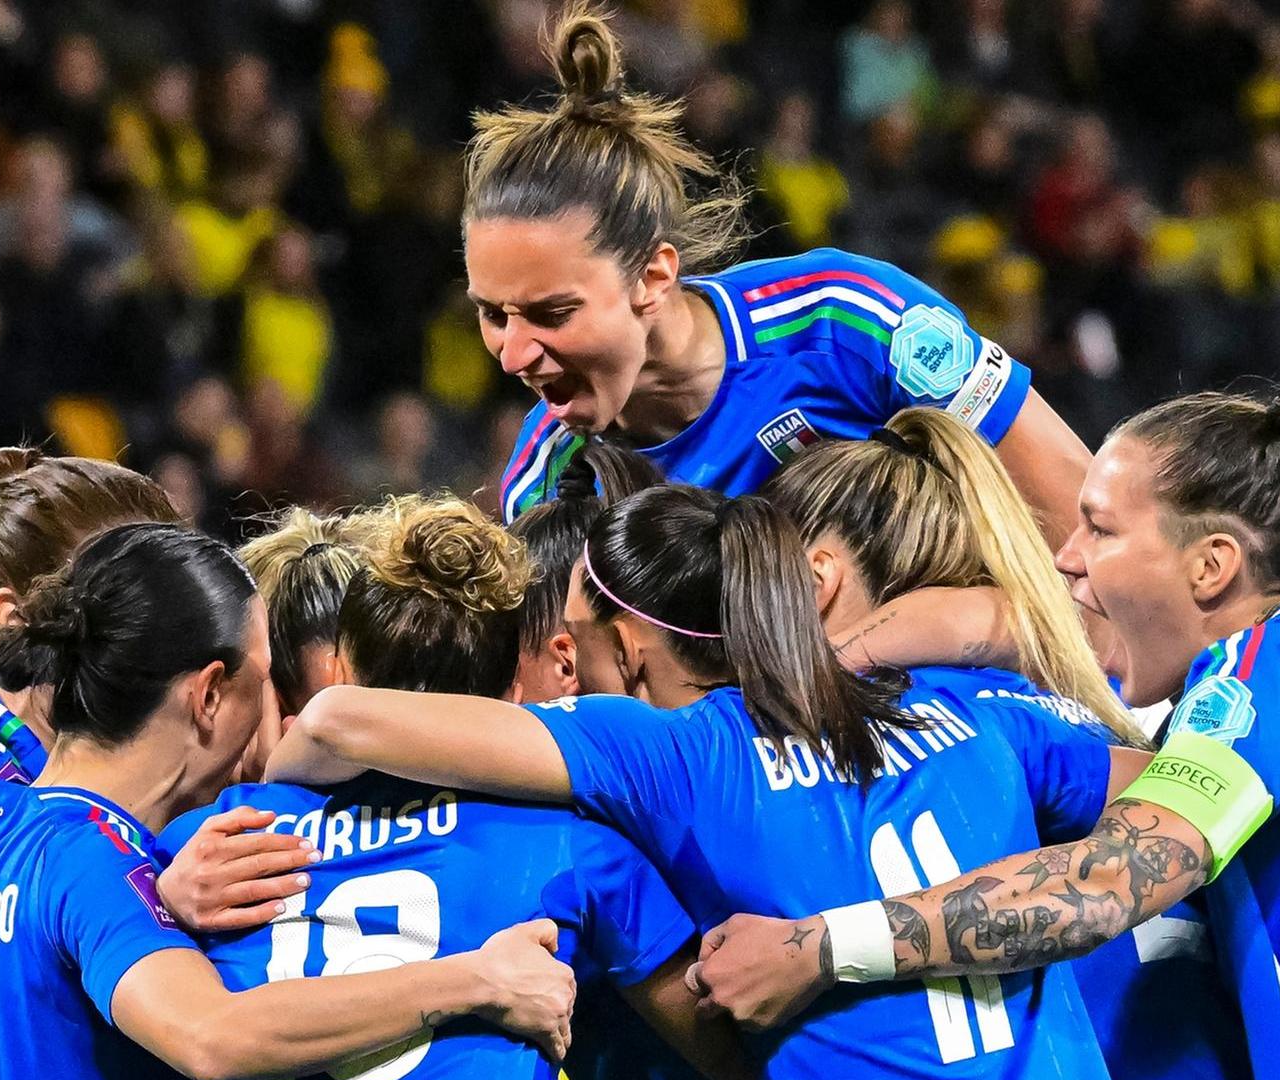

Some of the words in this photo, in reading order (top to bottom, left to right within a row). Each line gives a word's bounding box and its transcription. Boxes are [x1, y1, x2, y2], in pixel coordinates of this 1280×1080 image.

[762, 415, 803, 447] ITALIA
[1146, 760, 1227, 797] RESPECT
[869, 809, 1016, 1065] 11
